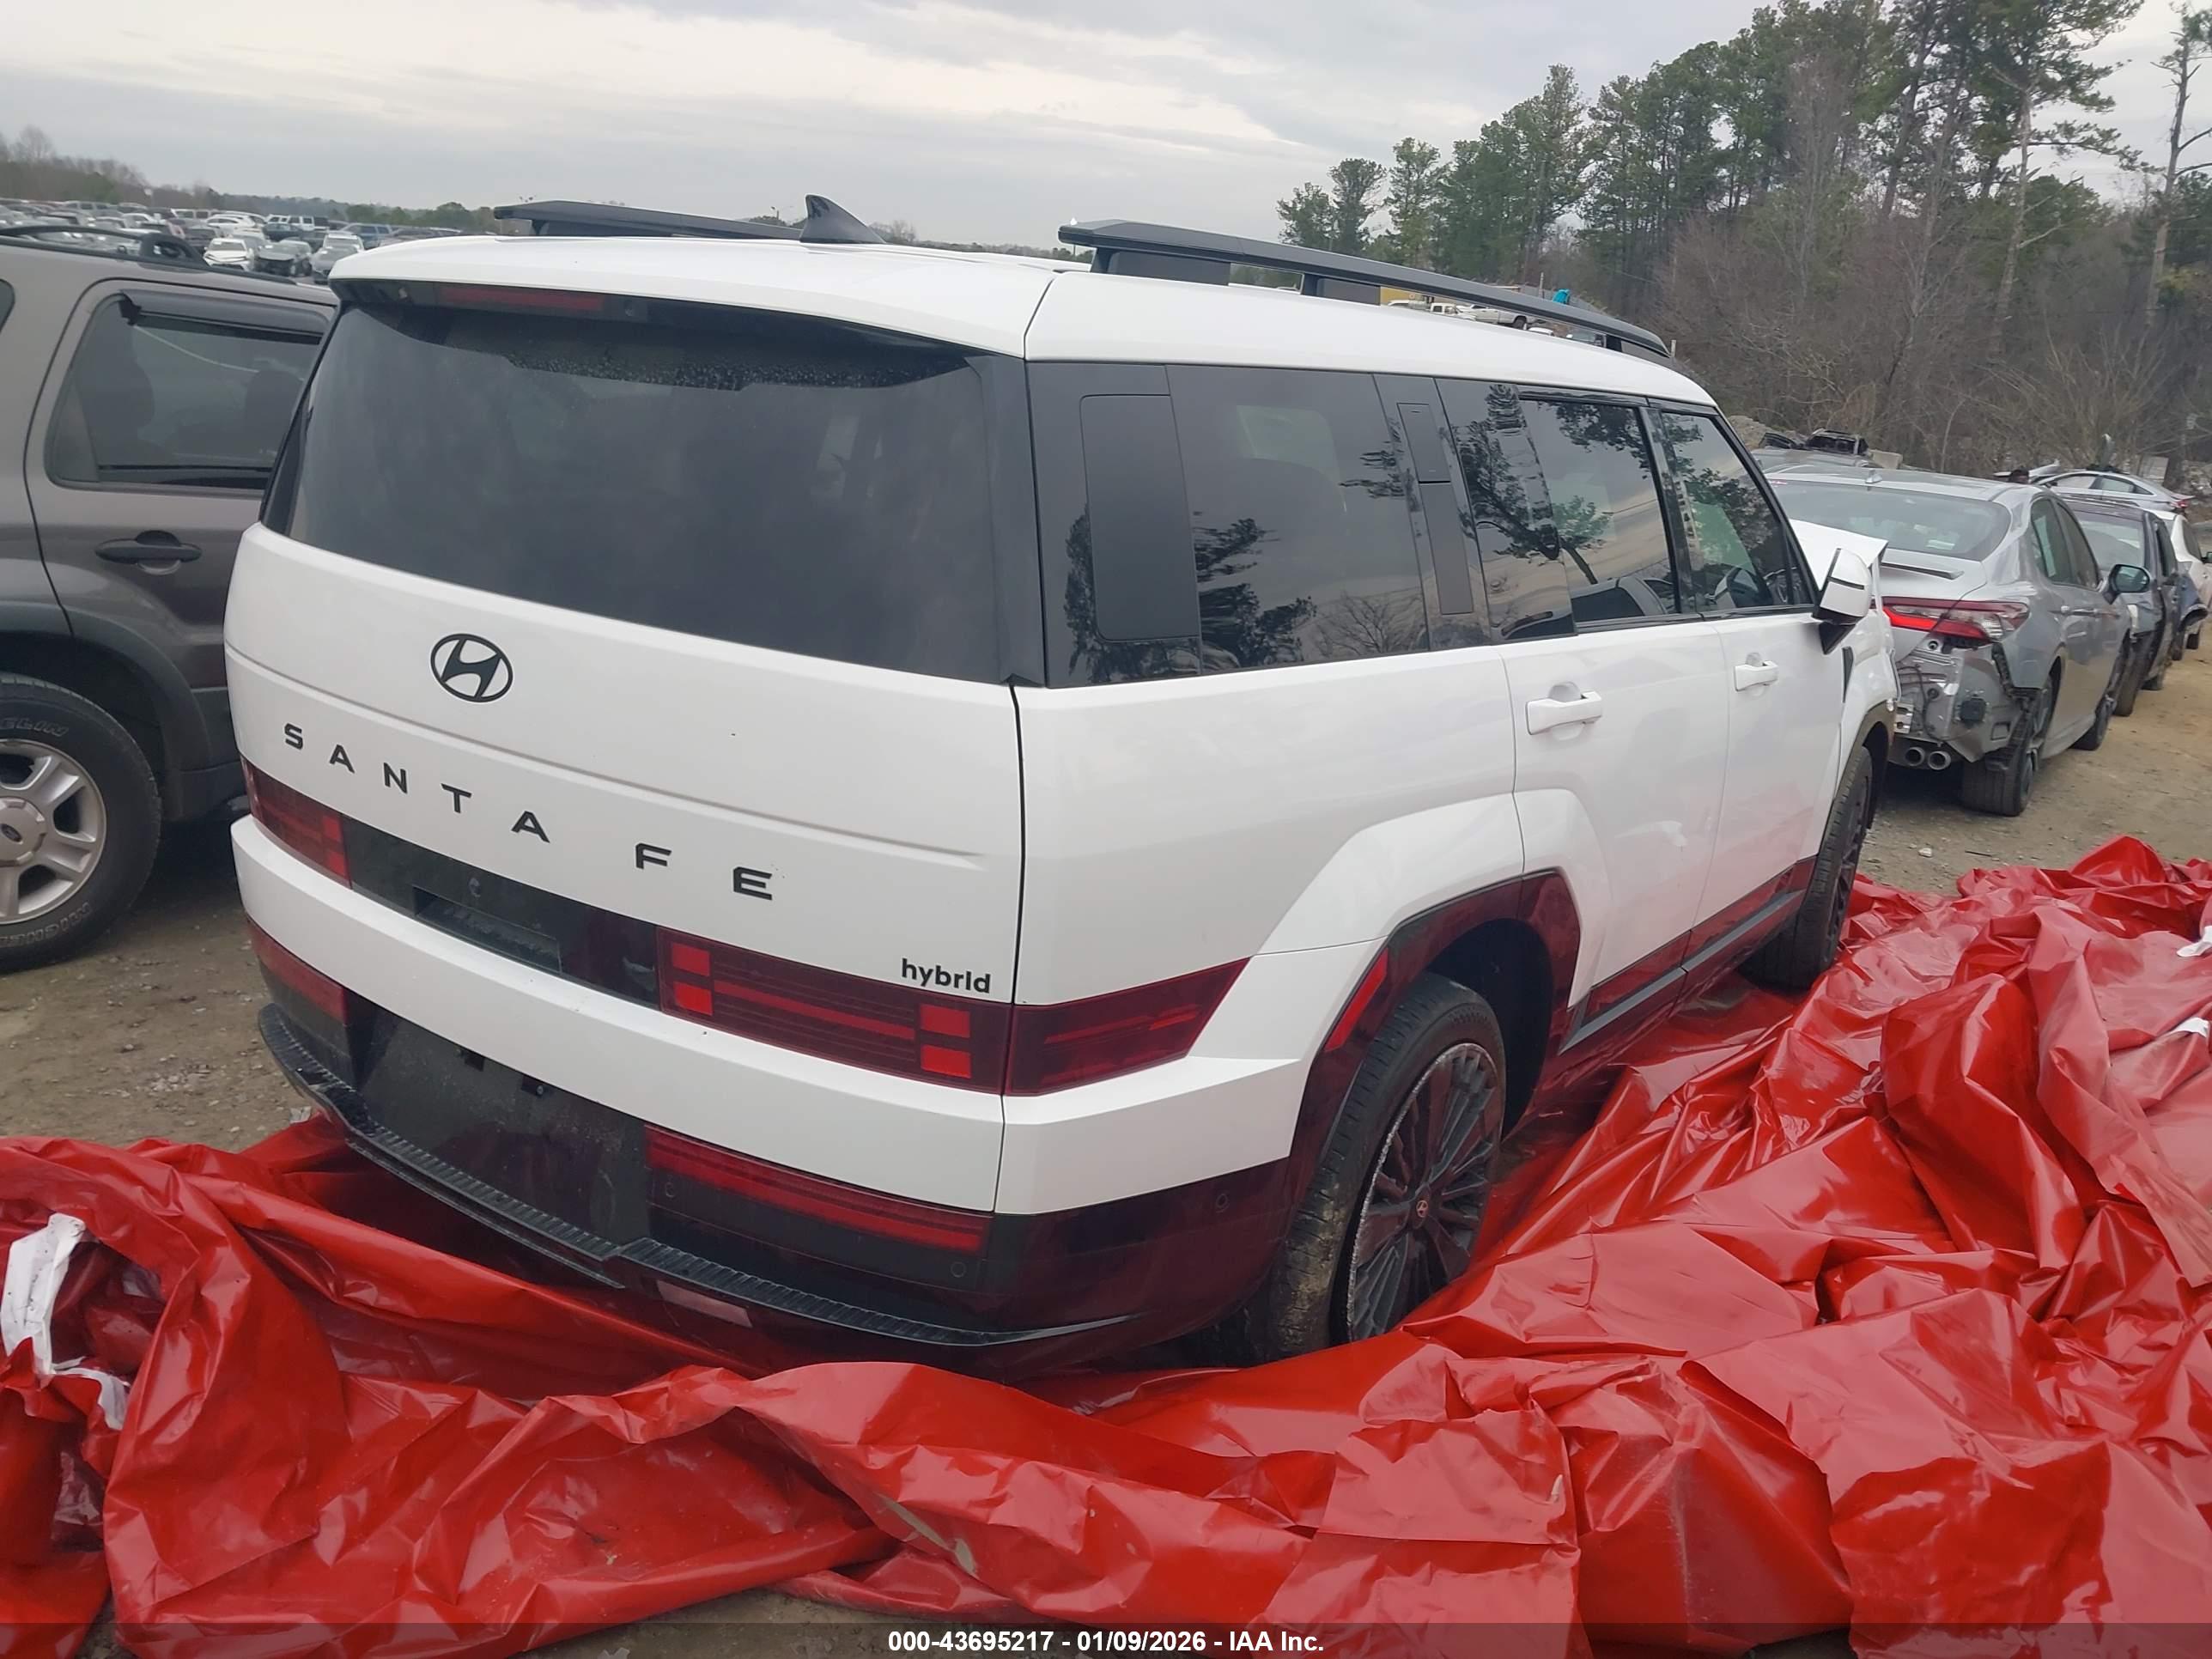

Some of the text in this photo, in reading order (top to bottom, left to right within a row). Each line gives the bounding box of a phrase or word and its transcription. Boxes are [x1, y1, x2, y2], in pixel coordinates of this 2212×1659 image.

[283, 722, 774, 902] SANTA FE
[901, 957, 991, 994] hybrid
